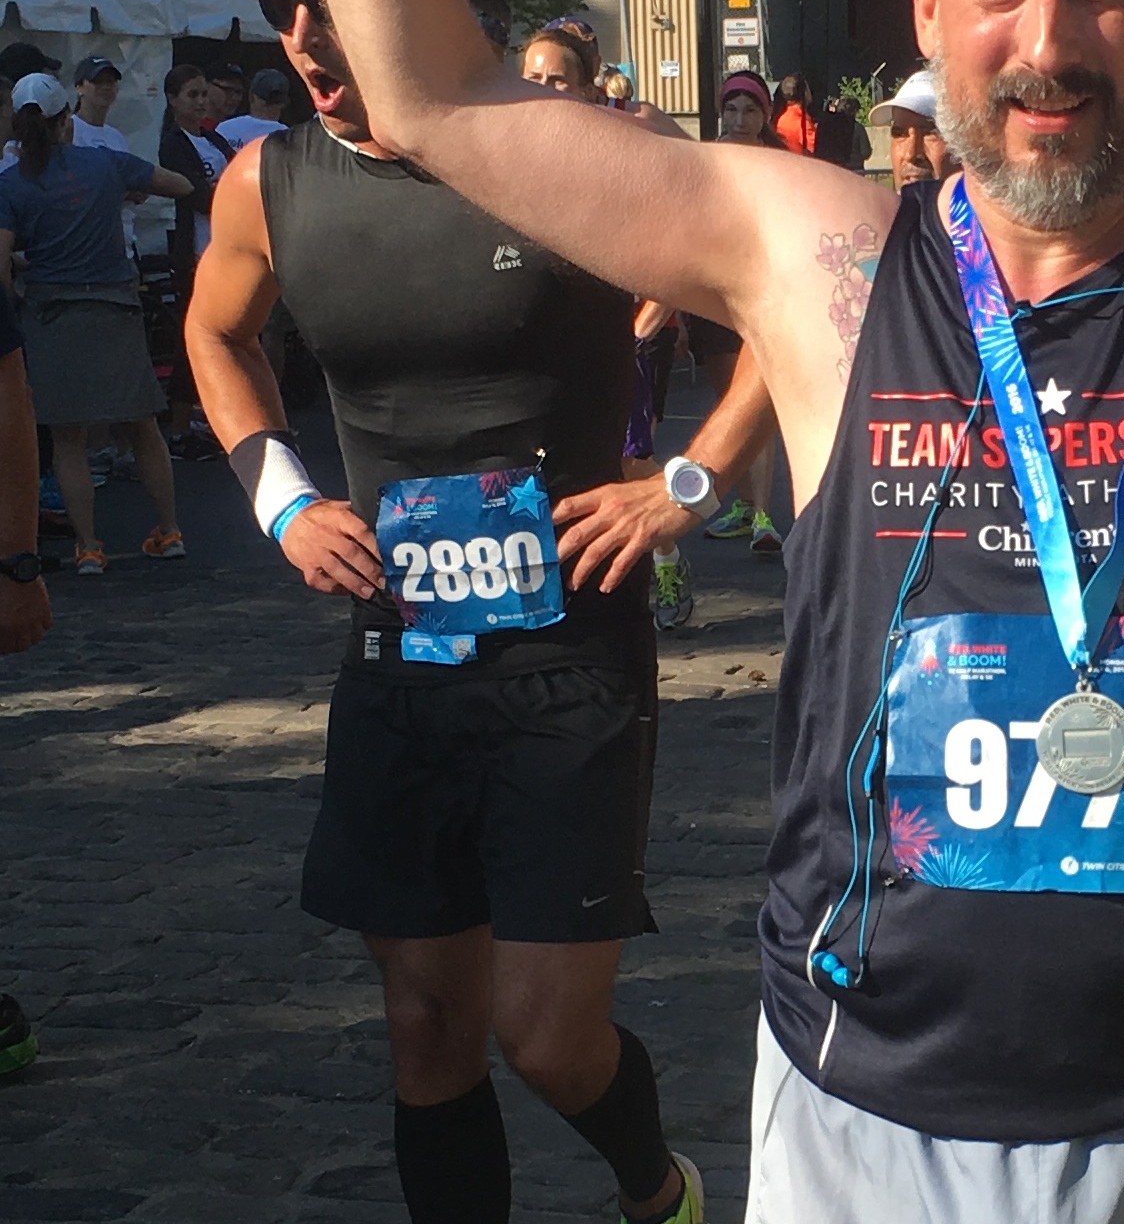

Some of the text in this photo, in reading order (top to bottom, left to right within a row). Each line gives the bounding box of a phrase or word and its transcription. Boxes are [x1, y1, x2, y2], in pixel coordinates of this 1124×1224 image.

[868, 422, 970, 467] TEAM
[392, 531, 546, 603] 2880
[946, 654, 1007, 666] & BOOM!
[1063, 695, 1091, 708] WHITE
[1082, 862, 1105, 871] TWIN
